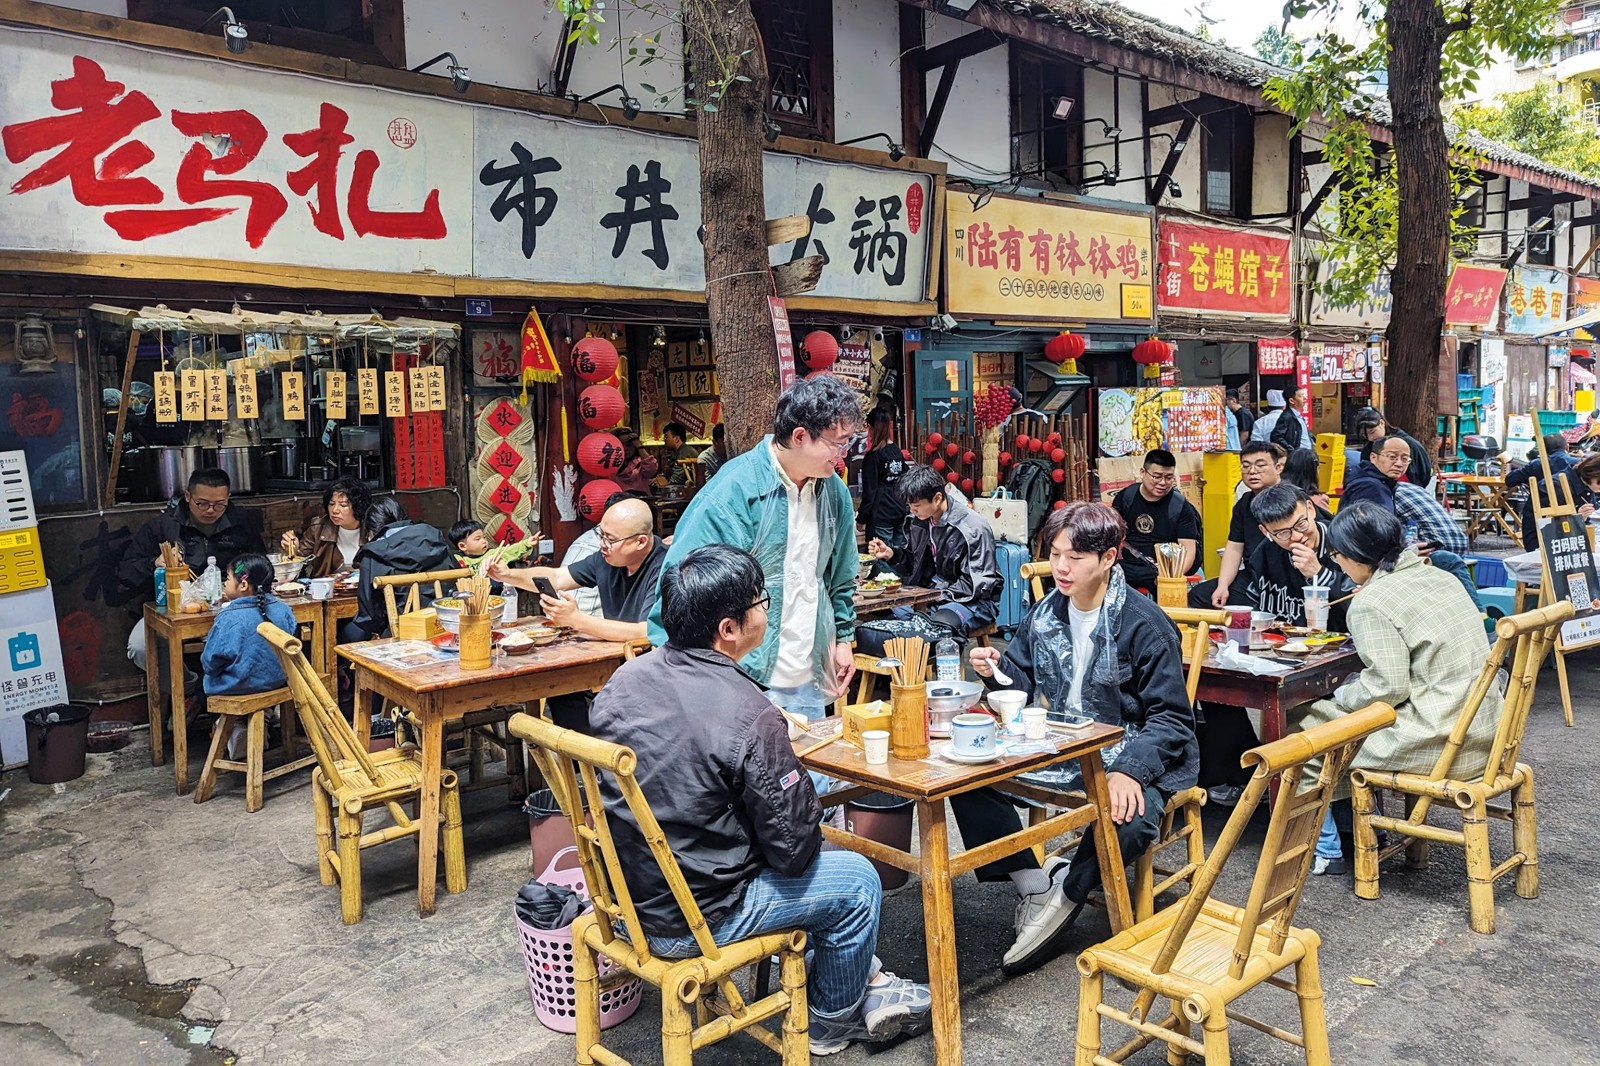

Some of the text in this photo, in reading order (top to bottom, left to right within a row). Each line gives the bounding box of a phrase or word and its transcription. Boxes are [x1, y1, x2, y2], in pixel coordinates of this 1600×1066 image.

[2, 55, 447, 249] 老马扎
[479, 141, 908, 287] 市井火锅
[955, 228, 964, 262] 四川
[967, 222, 1139, 281] 陆有有钵钵鸡
[1166, 233, 1182, 297] 十一街
[1188, 242, 1284, 299] 苍蝇馆子
[999, 277, 1104, 301] 二十五年地道乐山味
[1510, 284, 1562, 319] 巷巷面
[476, 306, 482, 314] 9
[571, 347, 596, 375] 福
[185, 375, 200, 414] 冒虾滑
[287, 377, 301, 413] 冒鸭血
[330, 376, 344, 409] 冒脑花
[1551, 534, 1587, 555] 扫码取号
[1554, 552, 1590, 572] 排队就餐
[1, 671, 57, 693] 怪兽充电
[3, 689, 28, 700] ENERGY
